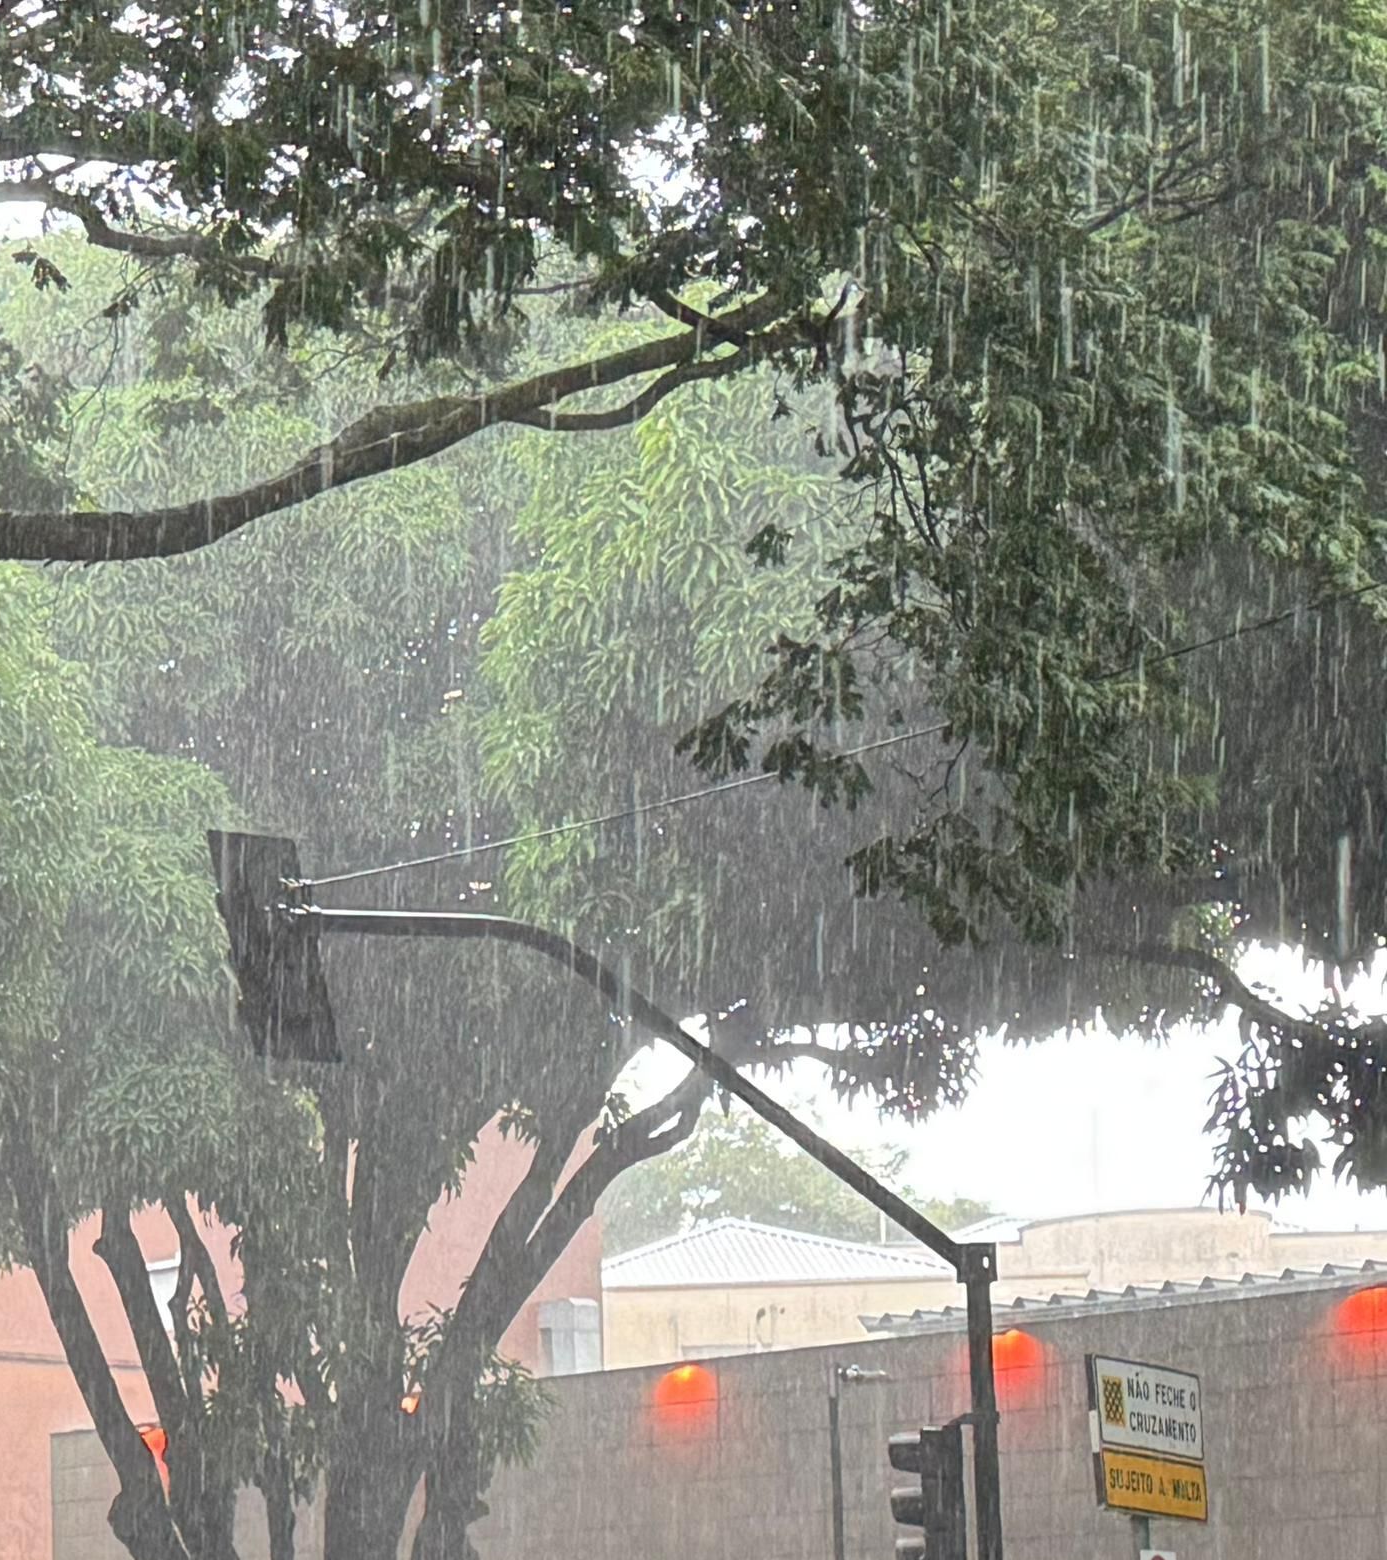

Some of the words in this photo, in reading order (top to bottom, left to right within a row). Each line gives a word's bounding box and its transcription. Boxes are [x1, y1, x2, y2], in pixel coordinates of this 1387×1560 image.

[1127, 1372, 1149, 1400] NÃO
[1155, 1383, 1186, 1409] FECHE
[1190, 1391, 1196, 1411] O
[1129, 1411, 1196, 1443] CRUZAMENTO
[1109, 1468, 1153, 1495] SUJEITO
[1172, 1479, 1202, 1503] MULTA
